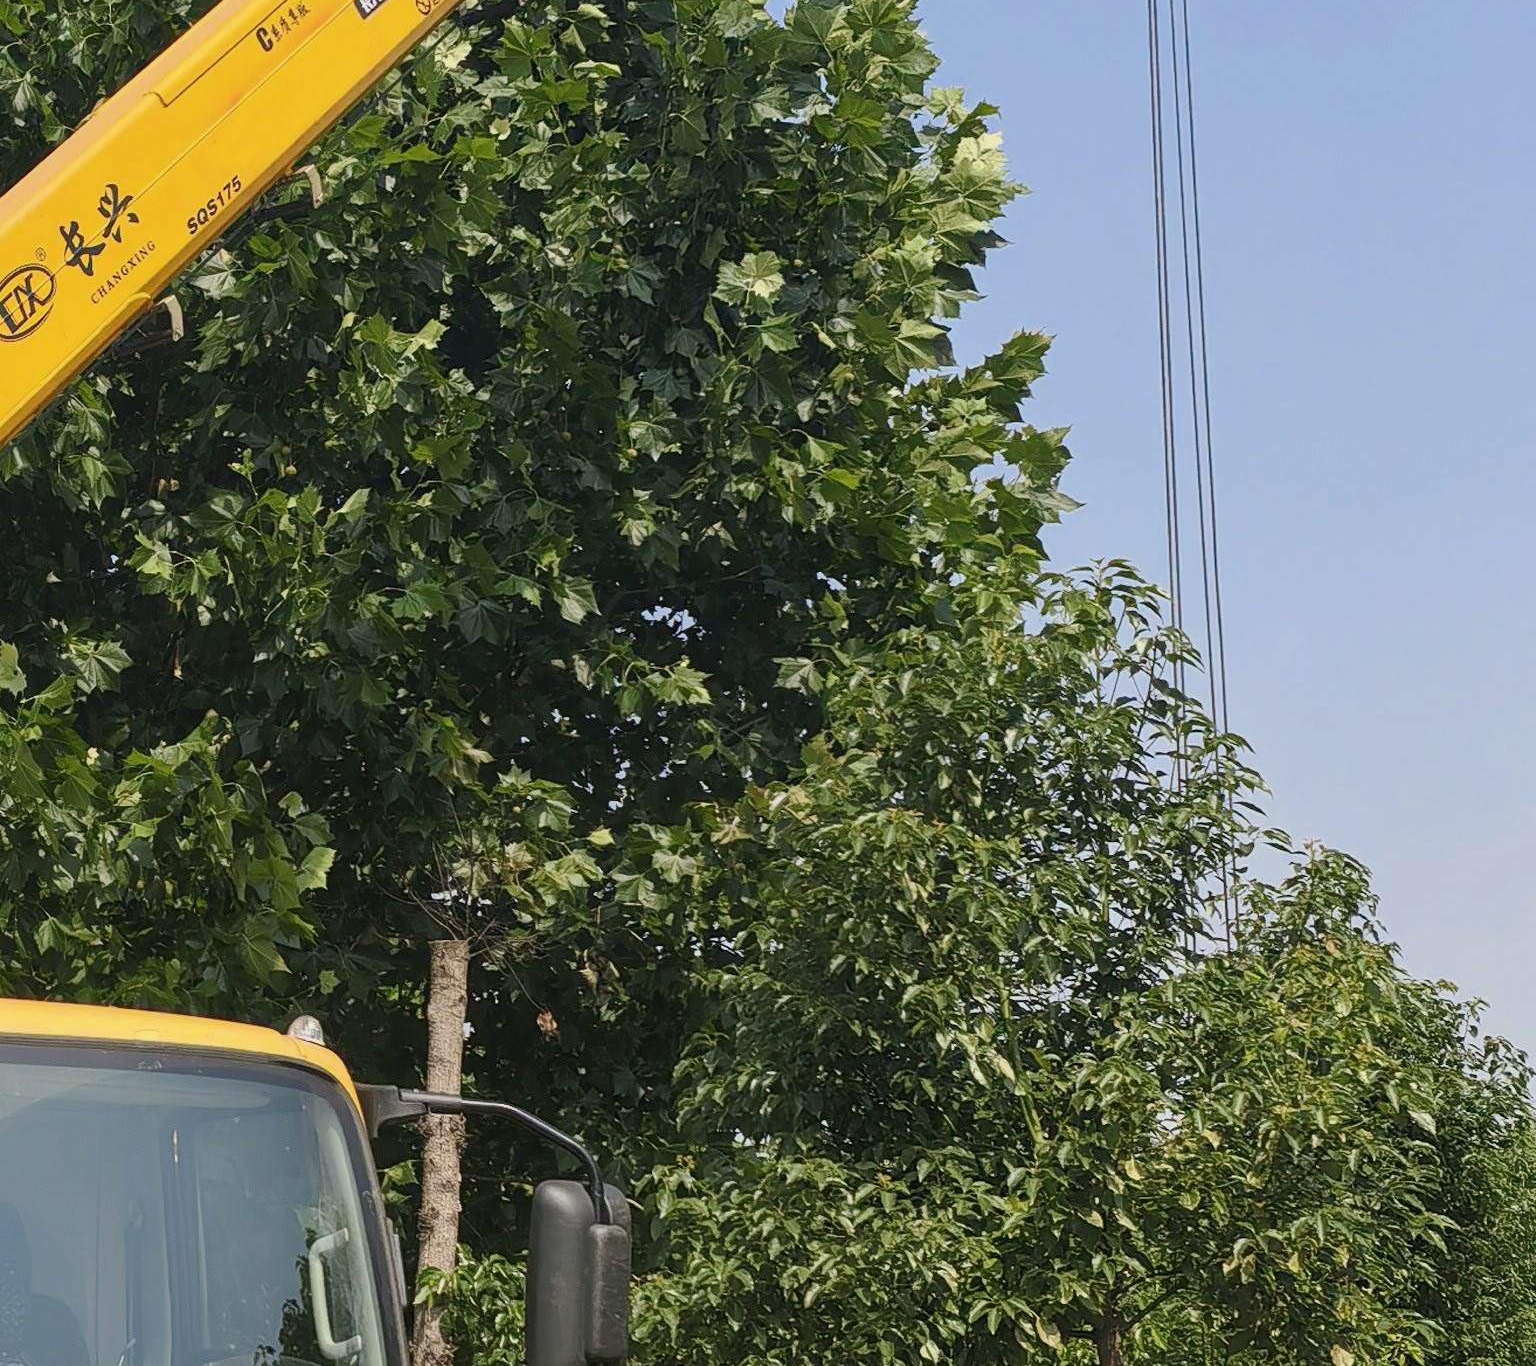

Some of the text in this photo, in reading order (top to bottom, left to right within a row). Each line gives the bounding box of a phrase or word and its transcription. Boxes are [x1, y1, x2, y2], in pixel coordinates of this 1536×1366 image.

[59, 183, 140, 277] 长兴
[186, 174, 243, 235] SQS175
[90, 239, 157, 304] CHANGXING
